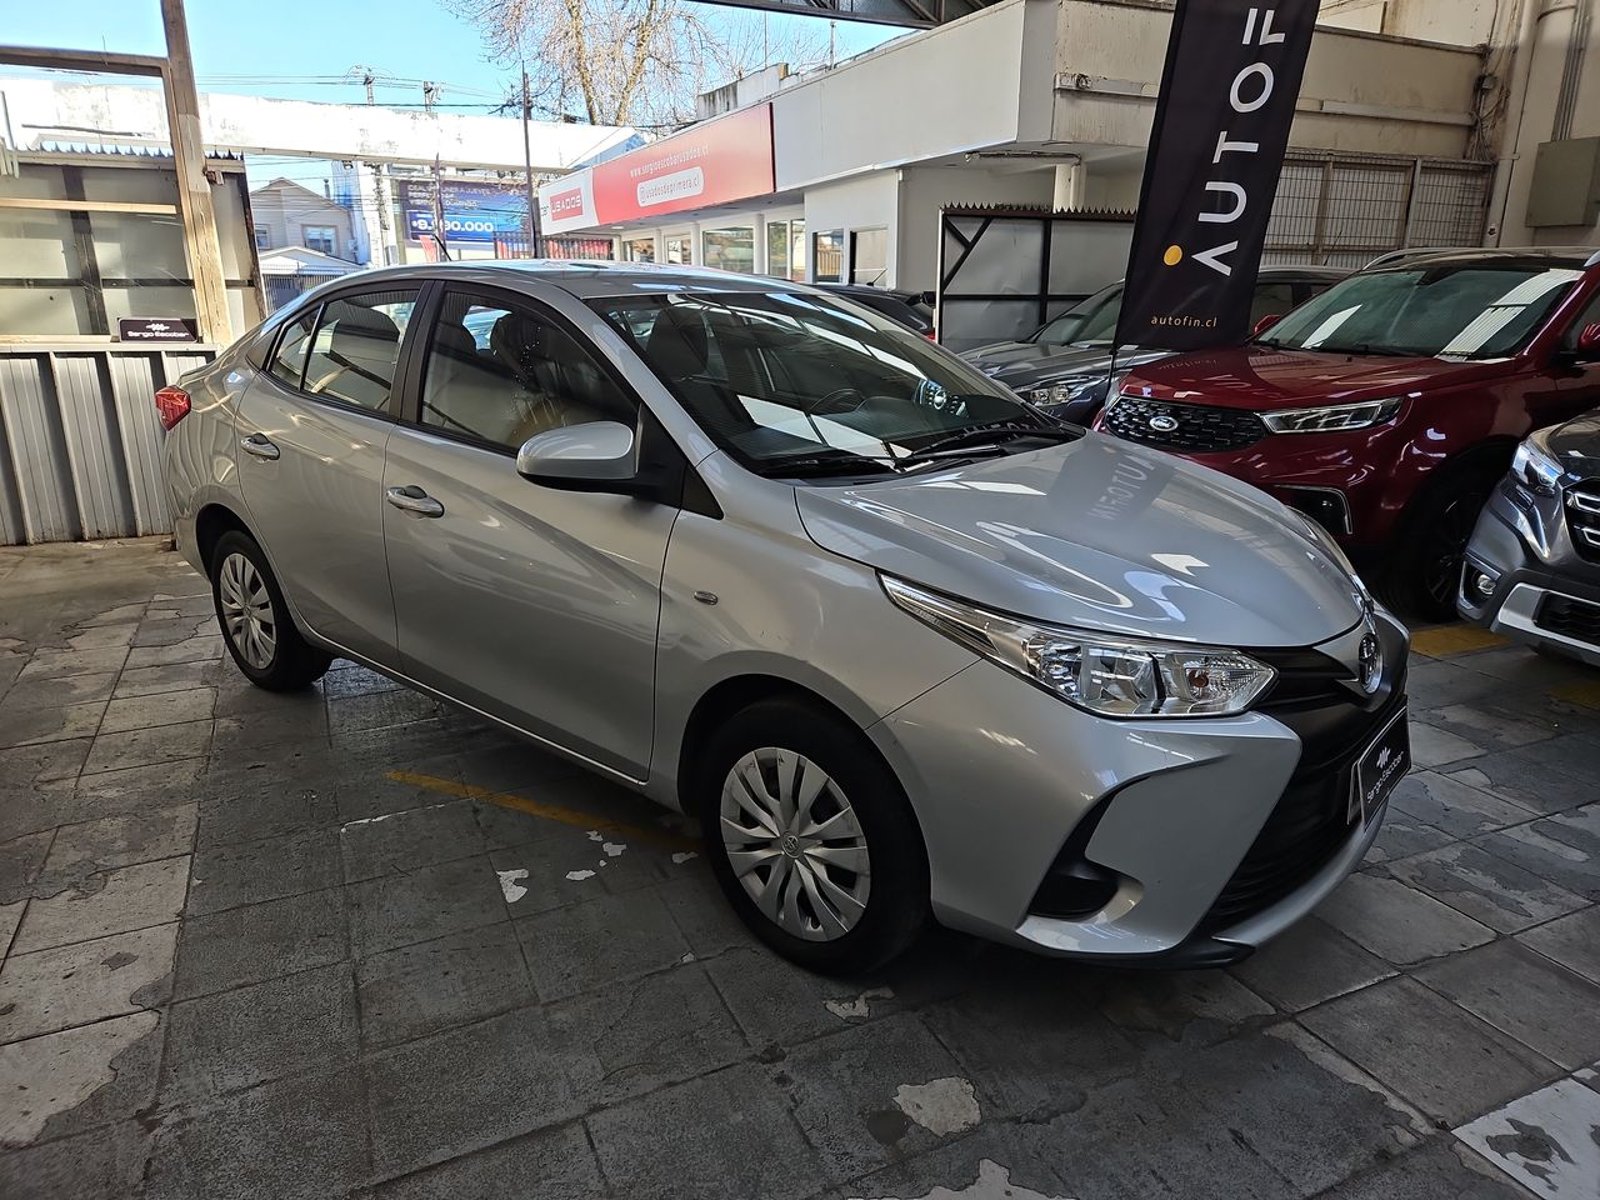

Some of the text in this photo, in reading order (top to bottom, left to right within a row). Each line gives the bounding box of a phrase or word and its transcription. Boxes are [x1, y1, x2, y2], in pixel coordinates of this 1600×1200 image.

[1191, 8, 1285, 277] AUTOF
[551, 195, 581, 213] USADOS
[1150, 315, 1217, 328] autofin.cl
